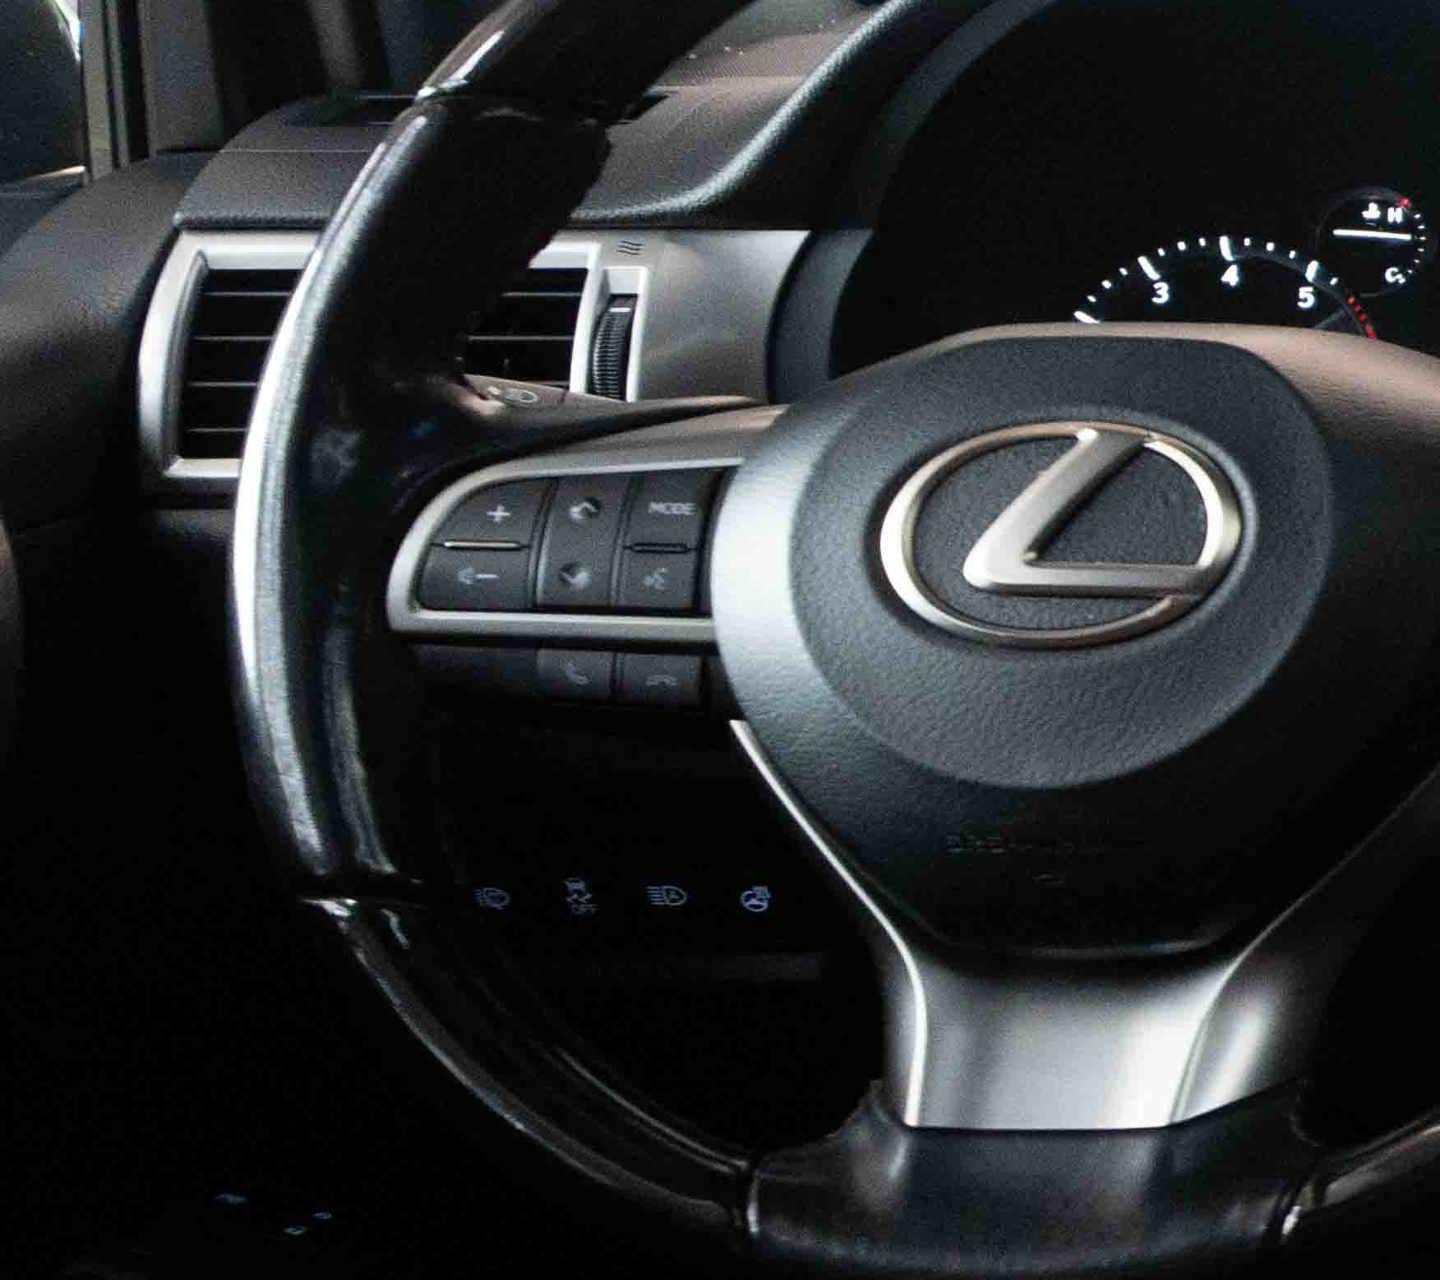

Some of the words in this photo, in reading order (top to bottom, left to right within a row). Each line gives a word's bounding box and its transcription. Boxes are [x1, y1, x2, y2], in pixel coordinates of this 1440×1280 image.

[1220, 264, 1239, 287] 4
[1151, 281, 1170, 304] 3
[1297, 285, 1316, 309] 5
[648, 501, 696, 516] MODE
